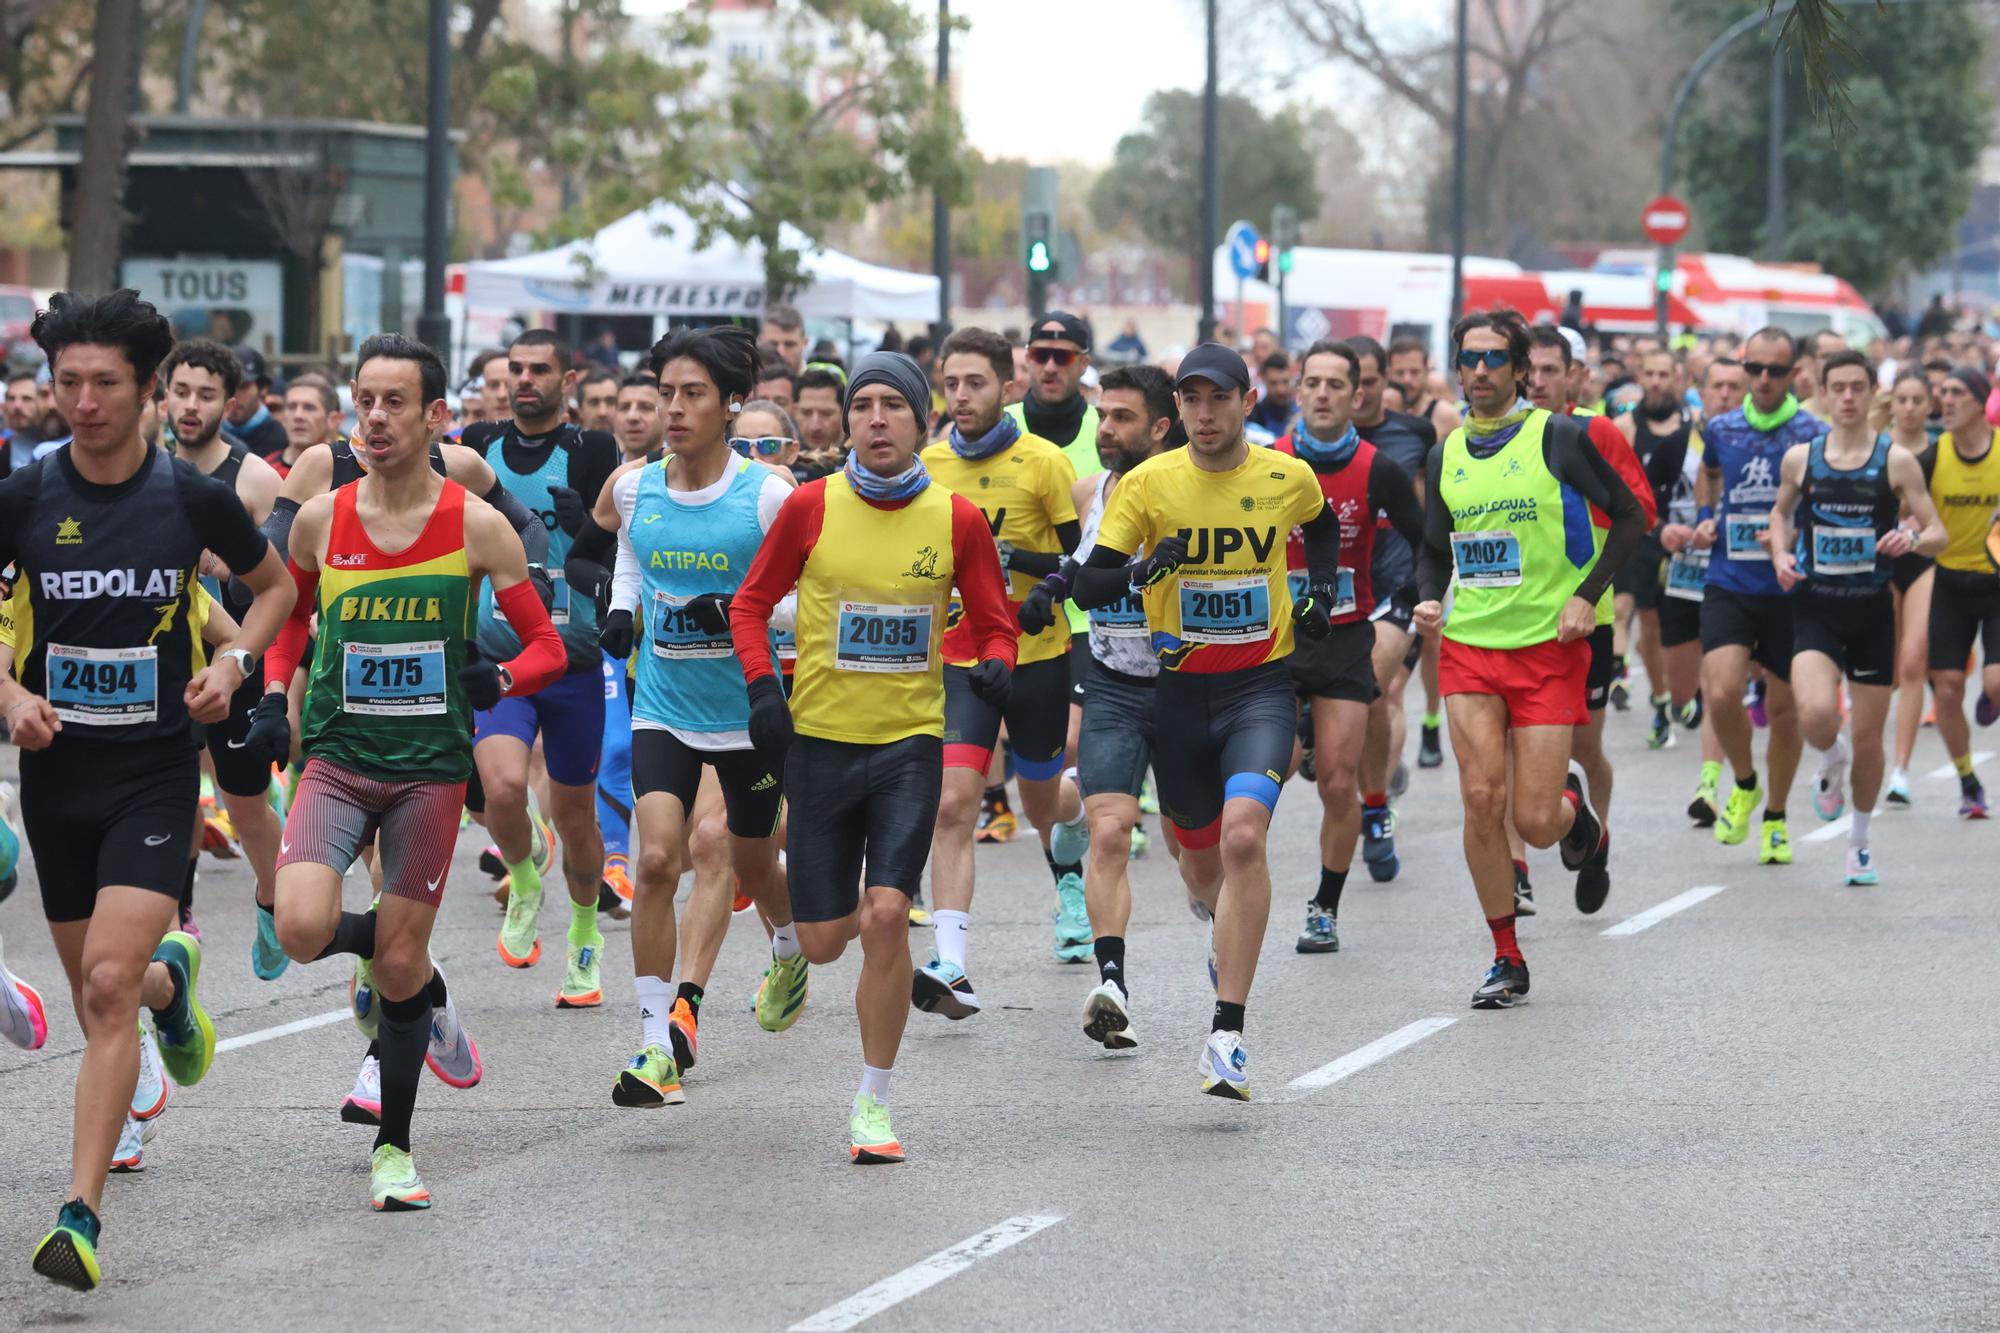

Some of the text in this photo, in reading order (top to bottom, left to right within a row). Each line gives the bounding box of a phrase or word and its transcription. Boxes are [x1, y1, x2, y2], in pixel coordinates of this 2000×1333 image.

[159, 269, 247, 300] TOUS
[1505, 510, 1538, 524] .ORG
[1181, 526, 1277, 565] UPV
[1461, 541, 1508, 564] 2002
[1820, 537, 1865, 555] 2334
[650, 550, 729, 572] ATIPAQ
[40, 568, 177, 600] REDOLAT
[340, 596, 442, 622] BIKILA
[1192, 590, 1252, 619] 2051
[0, 613, 15, 630] OS
[849, 616, 917, 646] 2035
[61, 659, 138, 694] 2494
[360, 657, 423, 687] 2175
